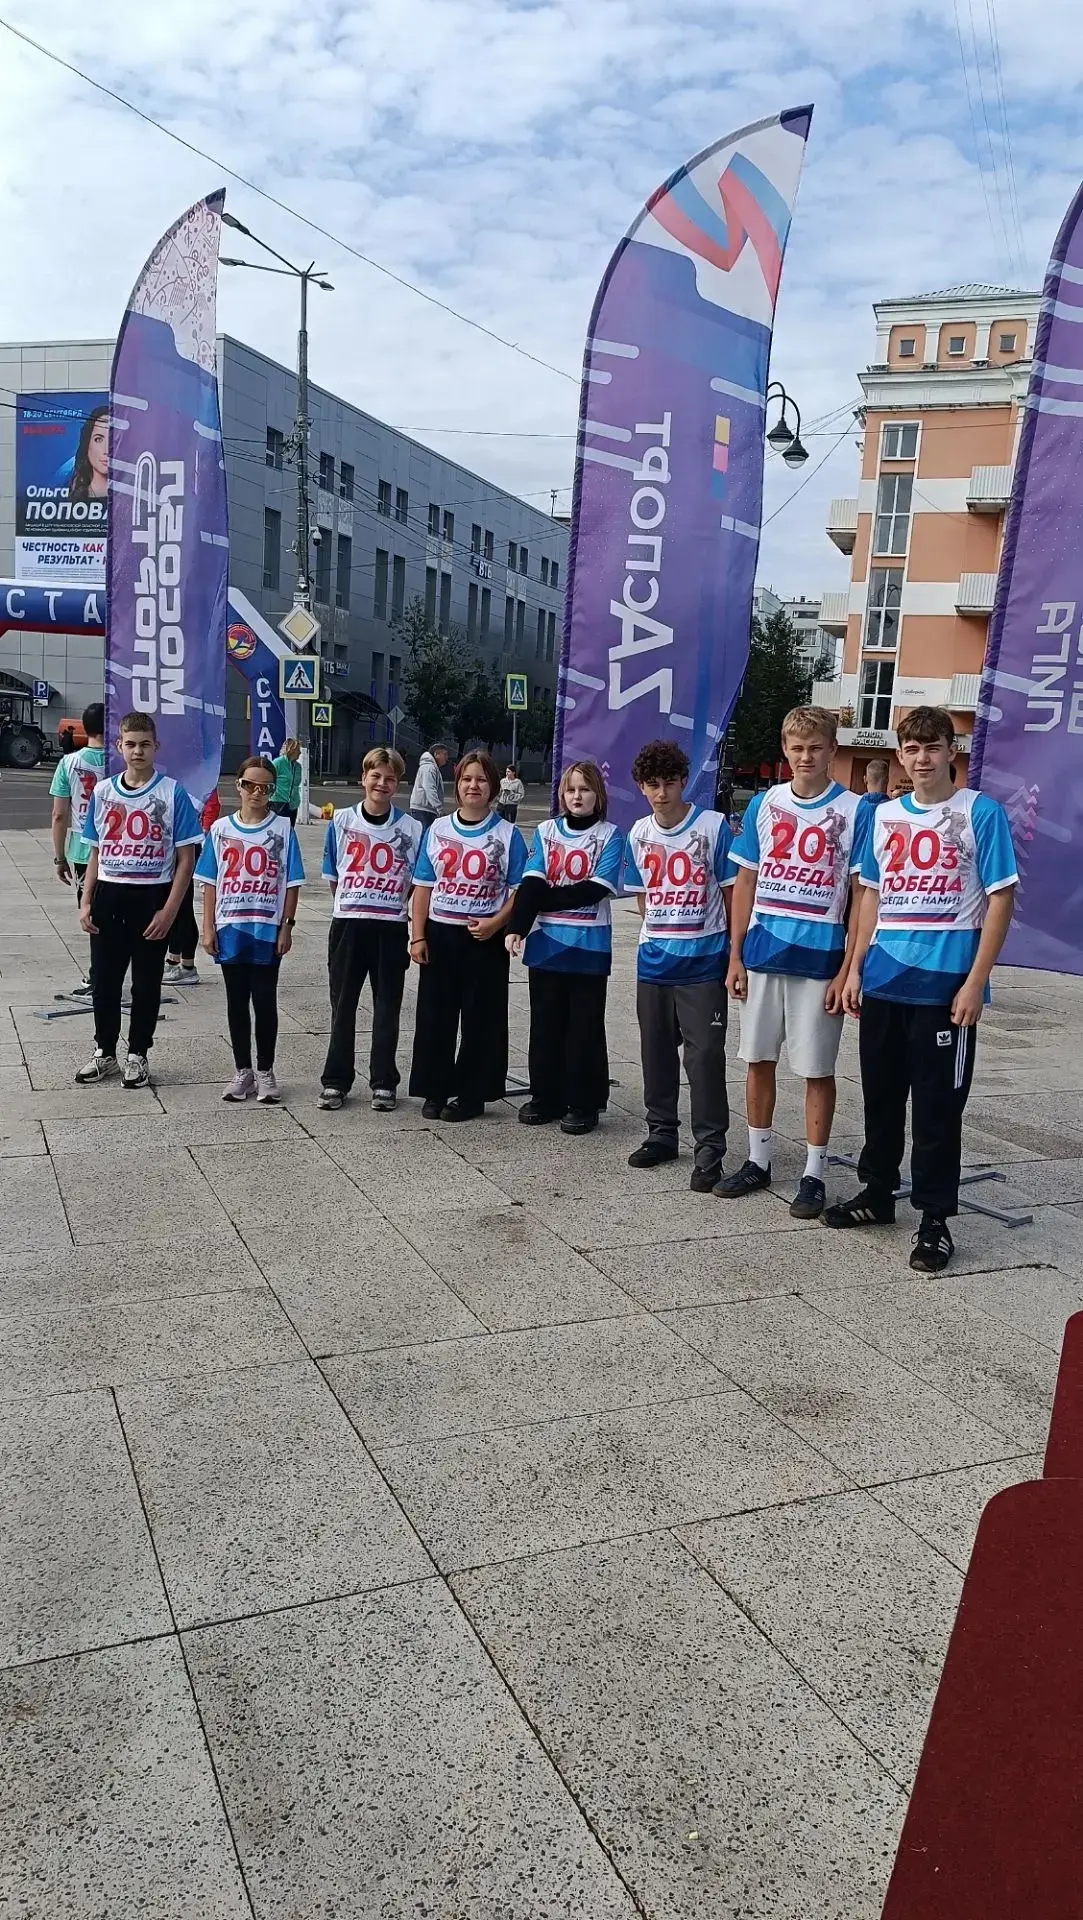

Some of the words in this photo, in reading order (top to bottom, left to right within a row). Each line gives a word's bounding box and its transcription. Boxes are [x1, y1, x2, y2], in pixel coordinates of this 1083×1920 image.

[26, 485, 70, 498] Ольга
[22, 542, 80, 552] ЧЕСТНОСТЬ
[82, 543, 104, 553] КАК
[37, 555, 94, 565] РЕЗУЛЬТАТ
[479, 560, 493, 579] ВТБ
[37, 682, 47, 695] P
[851, 738, 887, 747] КРАСОТЫ
[857, 730, 883, 739] САЛОН
[104, 809, 162, 842] 208
[101, 845, 165, 859] ПОБЕДА
[767, 822, 835, 866] 201
[884, 830, 958, 872] 203
[223, 846, 278, 878] 205
[346, 841, 405, 876] 207
[438, 848, 497, 882] 202
[644, 851, 706, 888] 206
[760, 862, 835, 888] ПОБЕДА
[222, 880, 279, 896] ПОБЕДА
[343, 876, 405, 895] ПОБЕДА
[437, 881, 497, 900] ПОБЕДА
[789, 885, 797, 893] С
[798, 886, 834, 900] НАМИ!
[882, 875, 962, 895] ПОБЕДА
[247, 896, 255, 904] С
[921, 896, 961, 905] НАМИ!
[669, 908, 677, 916] С
